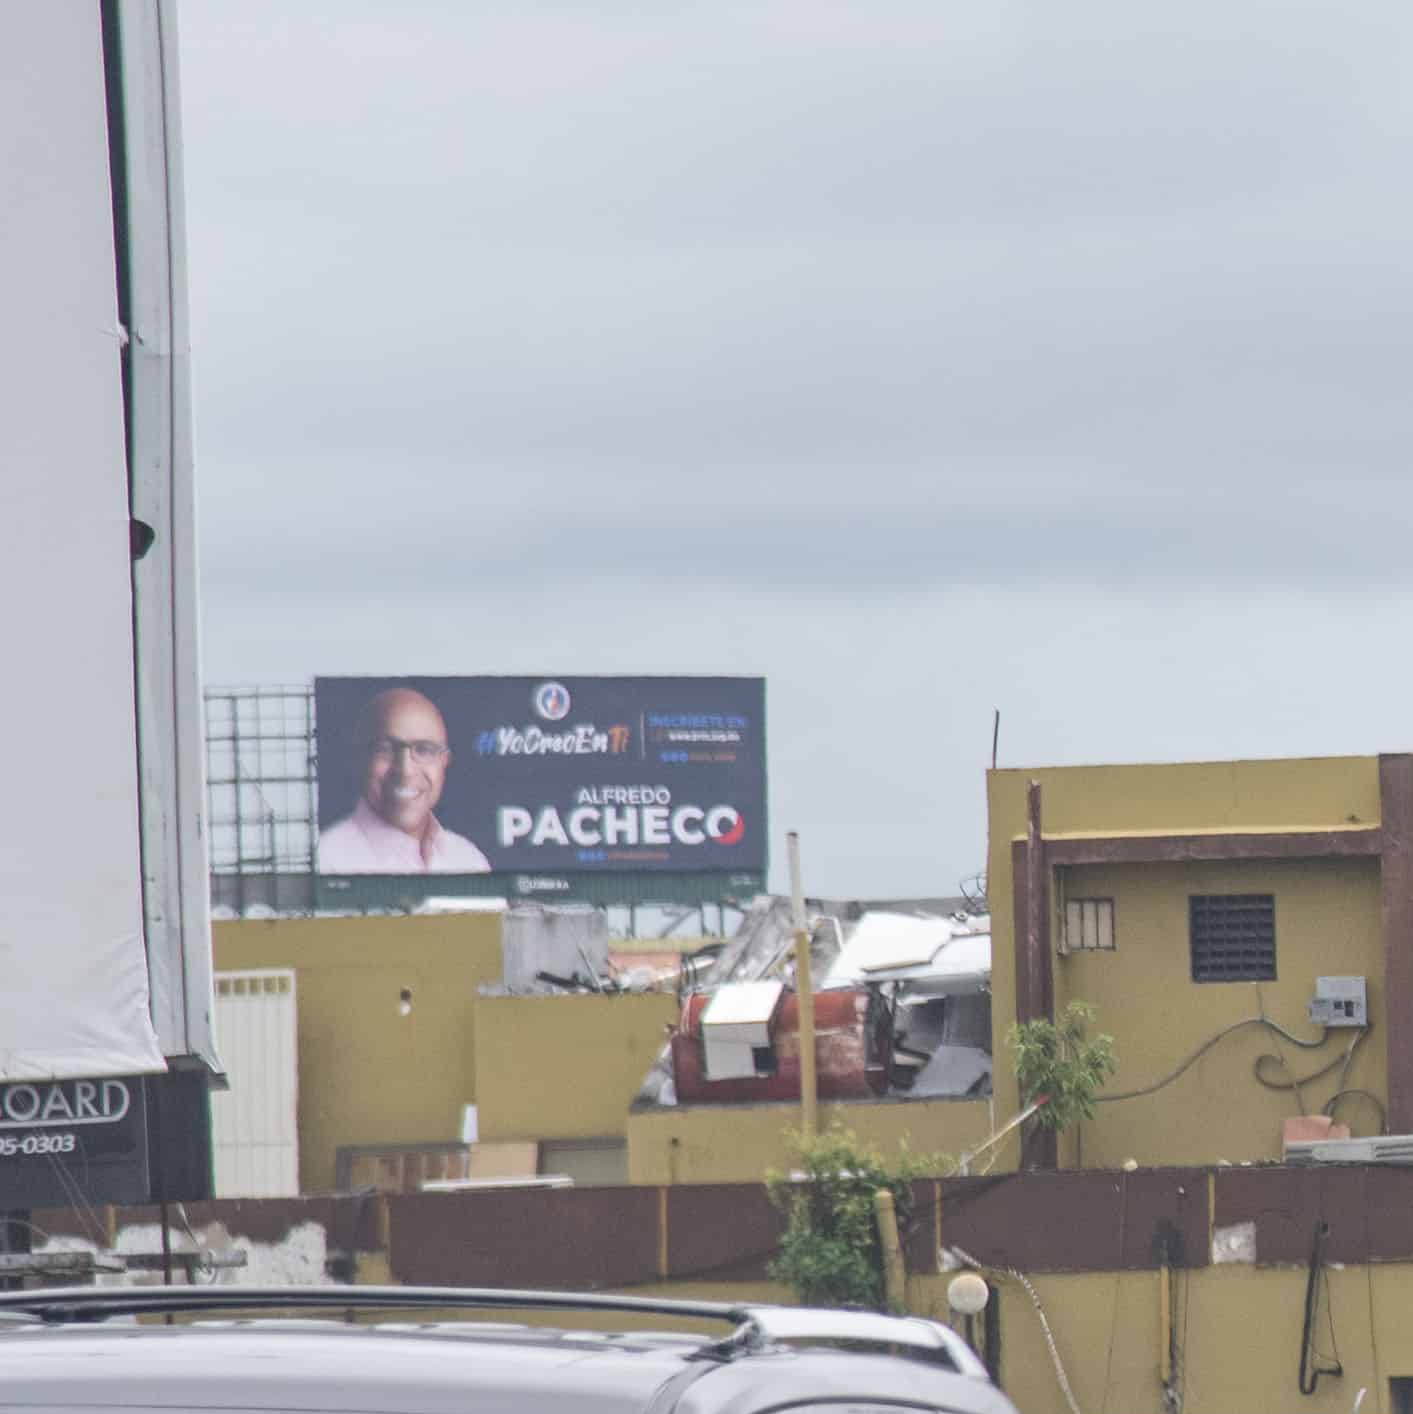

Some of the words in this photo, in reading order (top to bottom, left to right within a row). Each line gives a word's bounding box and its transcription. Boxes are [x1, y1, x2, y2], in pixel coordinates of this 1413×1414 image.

[578, 785, 671, 805] ALFREDO
[501, 806, 744, 846] PACHECO
[0, 1080, 130, 1121] OARD
